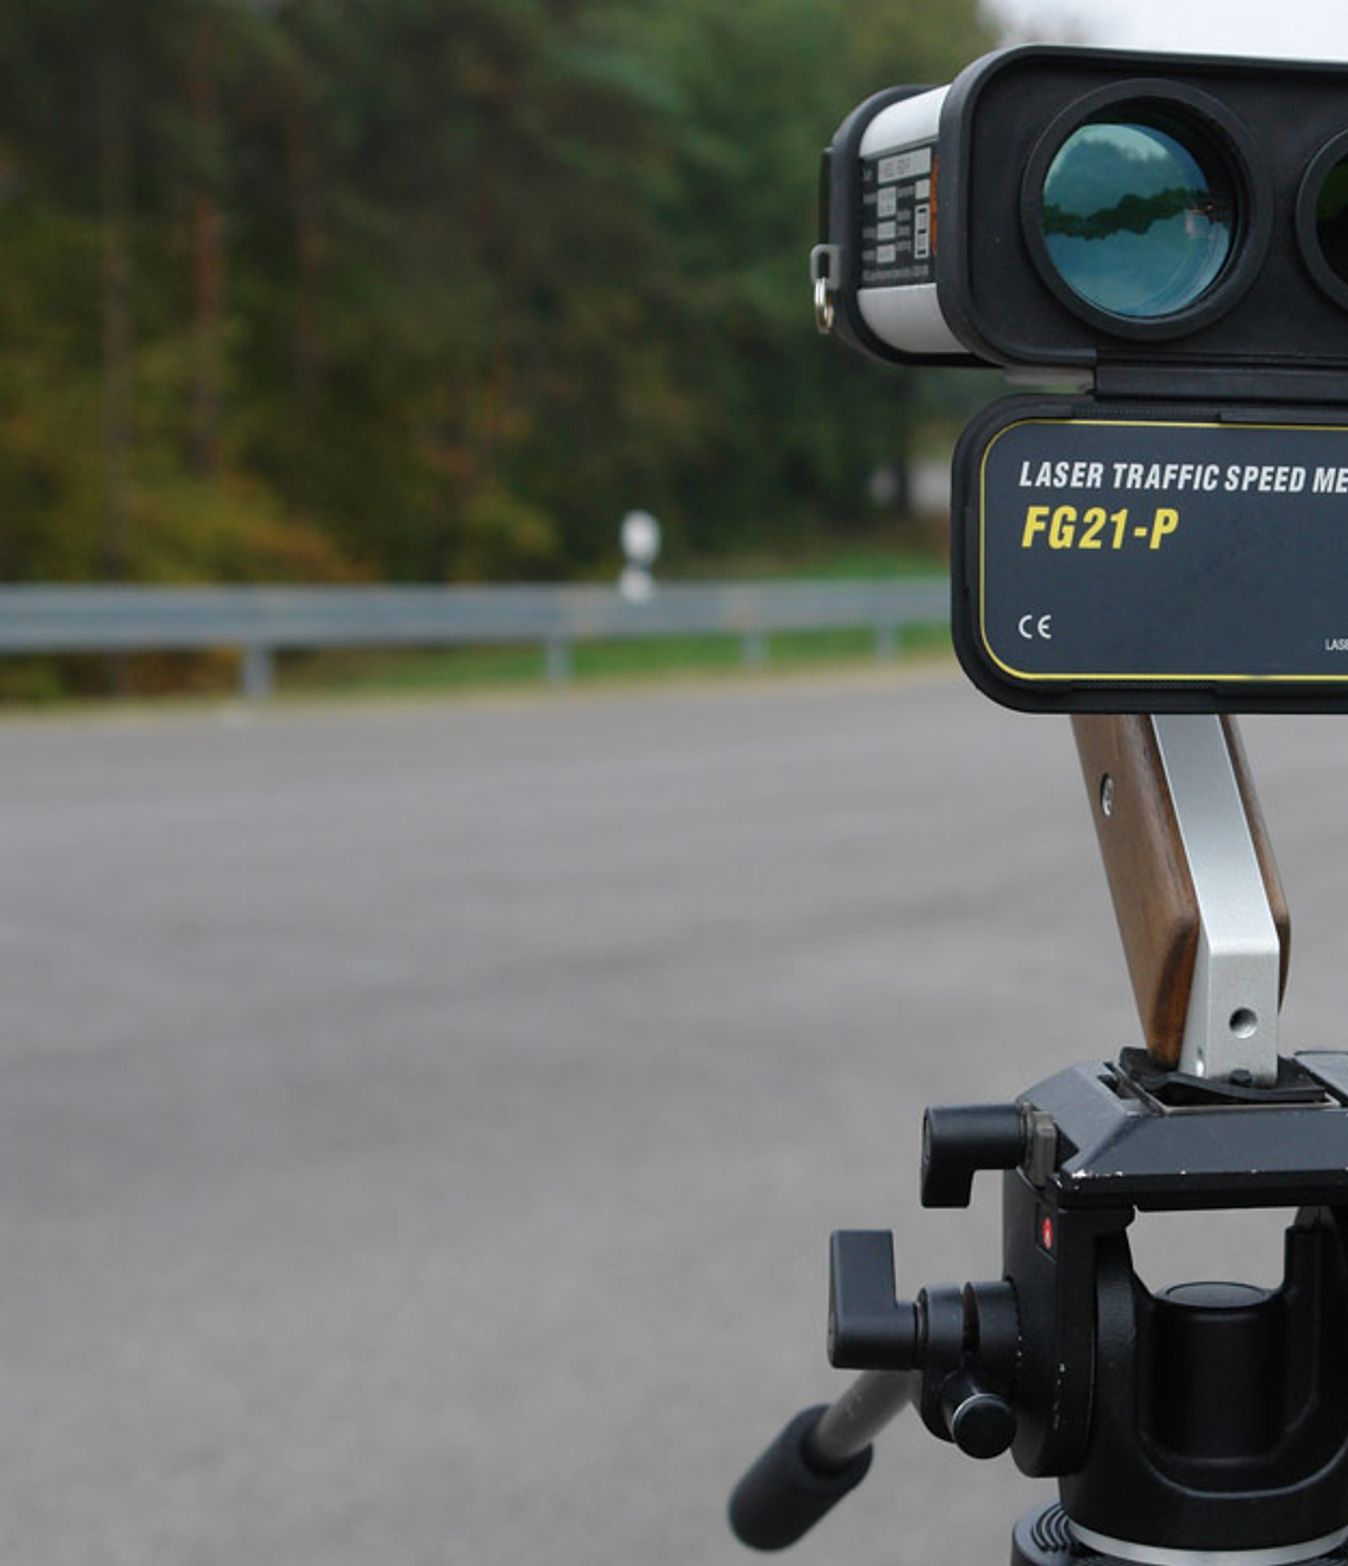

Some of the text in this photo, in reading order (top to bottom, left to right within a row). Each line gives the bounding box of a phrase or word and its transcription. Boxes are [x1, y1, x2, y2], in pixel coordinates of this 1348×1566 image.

[1018, 460, 1104, 490] LASER
[1112, 462, 1221, 492] TRAFFIC
[1223, 464, 1307, 493] SPEED
[1020, 504, 1180, 551] FG21-P
